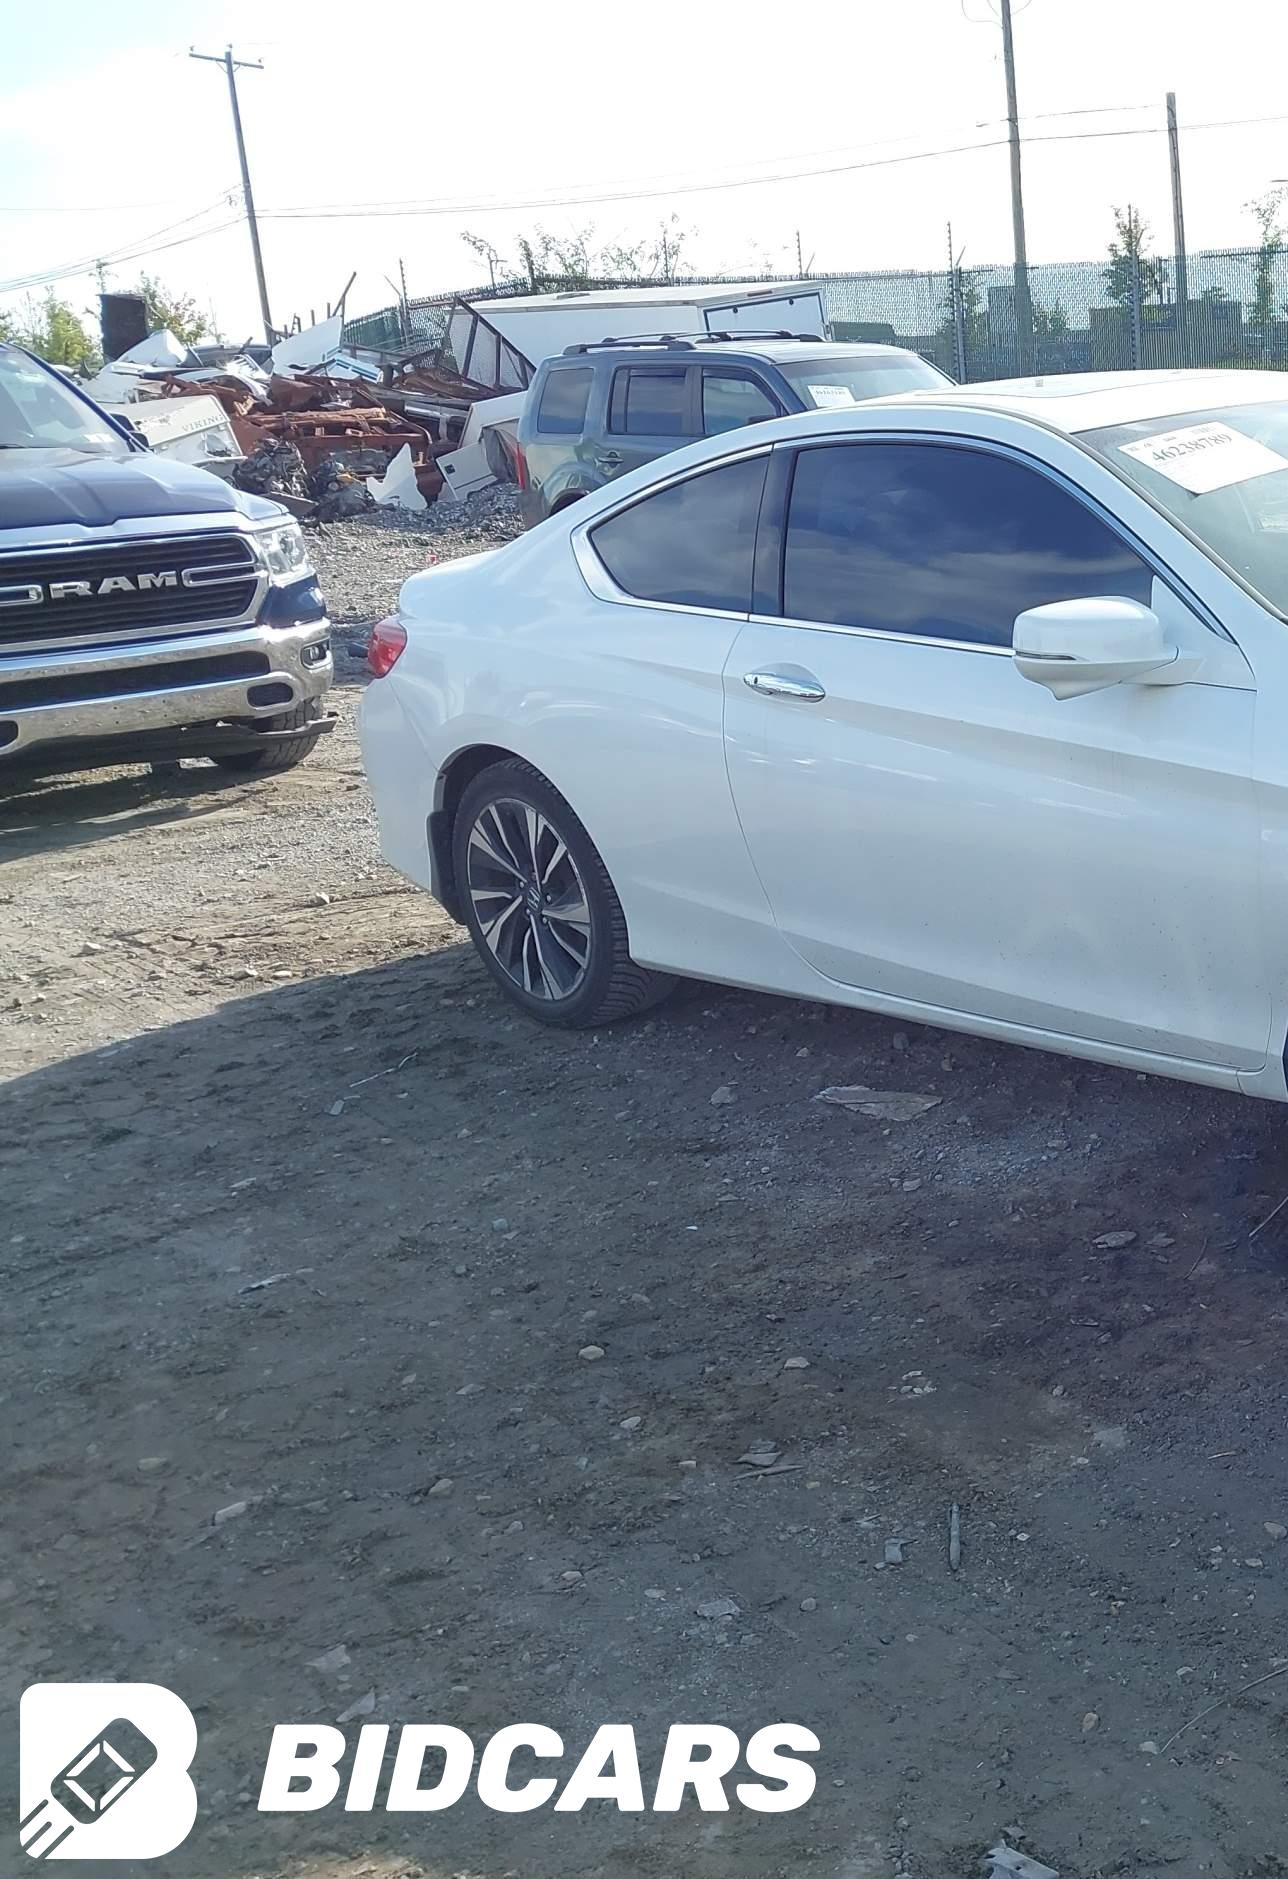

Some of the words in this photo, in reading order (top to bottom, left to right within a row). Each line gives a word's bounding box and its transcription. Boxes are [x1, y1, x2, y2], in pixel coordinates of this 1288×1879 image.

[182, 414, 225, 432] VIKING
[1152, 433, 1233, 461] 46238789
[49, 571, 178, 599] RAM
